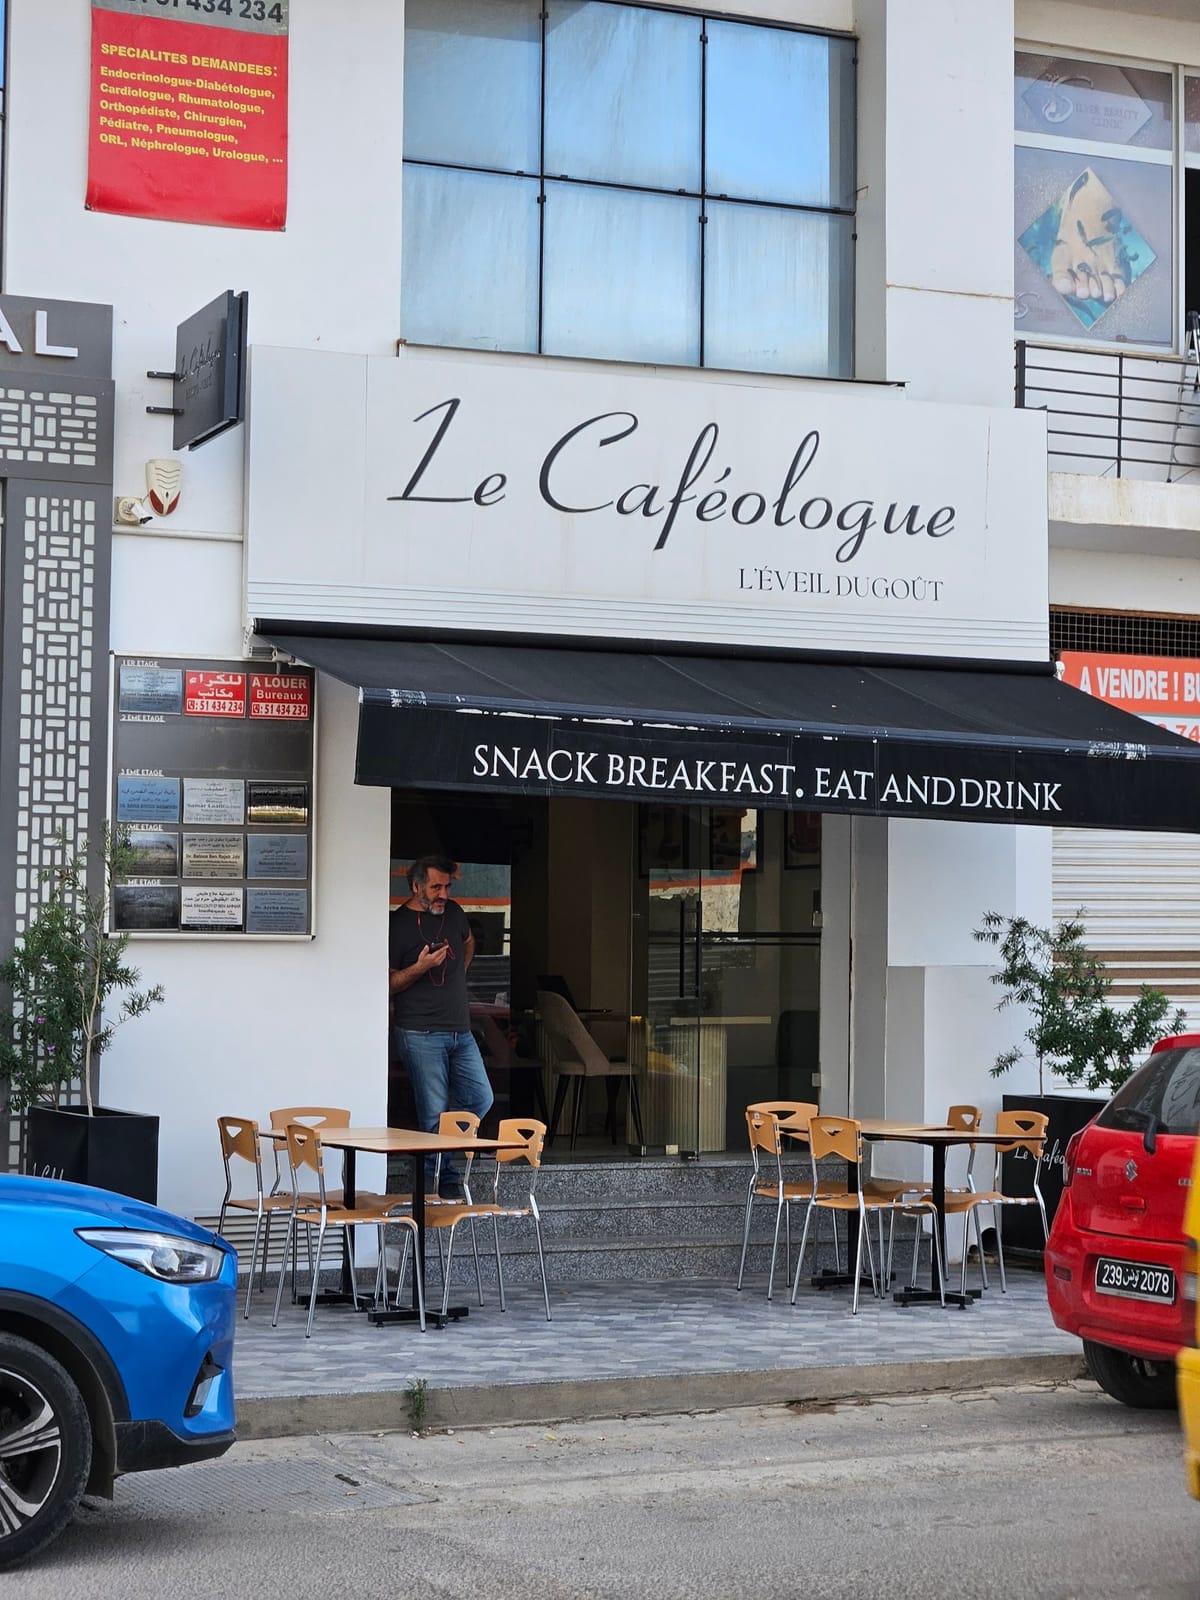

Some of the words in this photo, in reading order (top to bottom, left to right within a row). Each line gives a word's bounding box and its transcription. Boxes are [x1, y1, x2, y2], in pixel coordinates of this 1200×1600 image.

[239, 0, 283, 23] 234
[100, 43, 188, 65] SPECIALITES
[192, 55, 278, 77] DEMANDEES:
[100, 66, 276, 99] Endocrinologue-Diabétologue,
[100, 83, 175, 103] Cardiologue,
[178, 93, 265, 115] Rhumatologue,
[100, 100, 180, 120] Orthopédiste,
[183, 110, 247, 129] Chirurgien,
[100, 116, 153, 134] Pédiatre,
[156, 124, 239, 145] Pneumologue,
[100, 133, 127, 147] ORL,
[131, 138, 209, 158] Néphrologue,
[212, 147, 269, 163] Urologue,
[387, 398, 507, 506] Le
[539, 411, 956, 563] Caféologue
[189, 673, 242, 687] للكراء
[198, 688, 234, 700] مكاتب
[252, 677, 261, 687] A
[265, 677, 306, 688] LOUER
[256, 689, 304, 700] Bureaux
[1080, 666, 1092, 695] A
[1096, 667, 1169, 700] VENDRE
[200, 701, 209, 710] 51
[212, 701, 227, 711] 434
[228, 702, 242, 712] 234
[264, 703, 273, 713] 51
[276, 704, 290, 714] 434
[292, 704, 306, 716] 234
[472, 744, 598, 784] SNACK
[814, 767, 874, 800] EAT
[1102, 1264, 1122, 1286] 239
[1122, 1268, 1140, 1288] تونس
[1140, 1270, 1170, 1294] 2078
